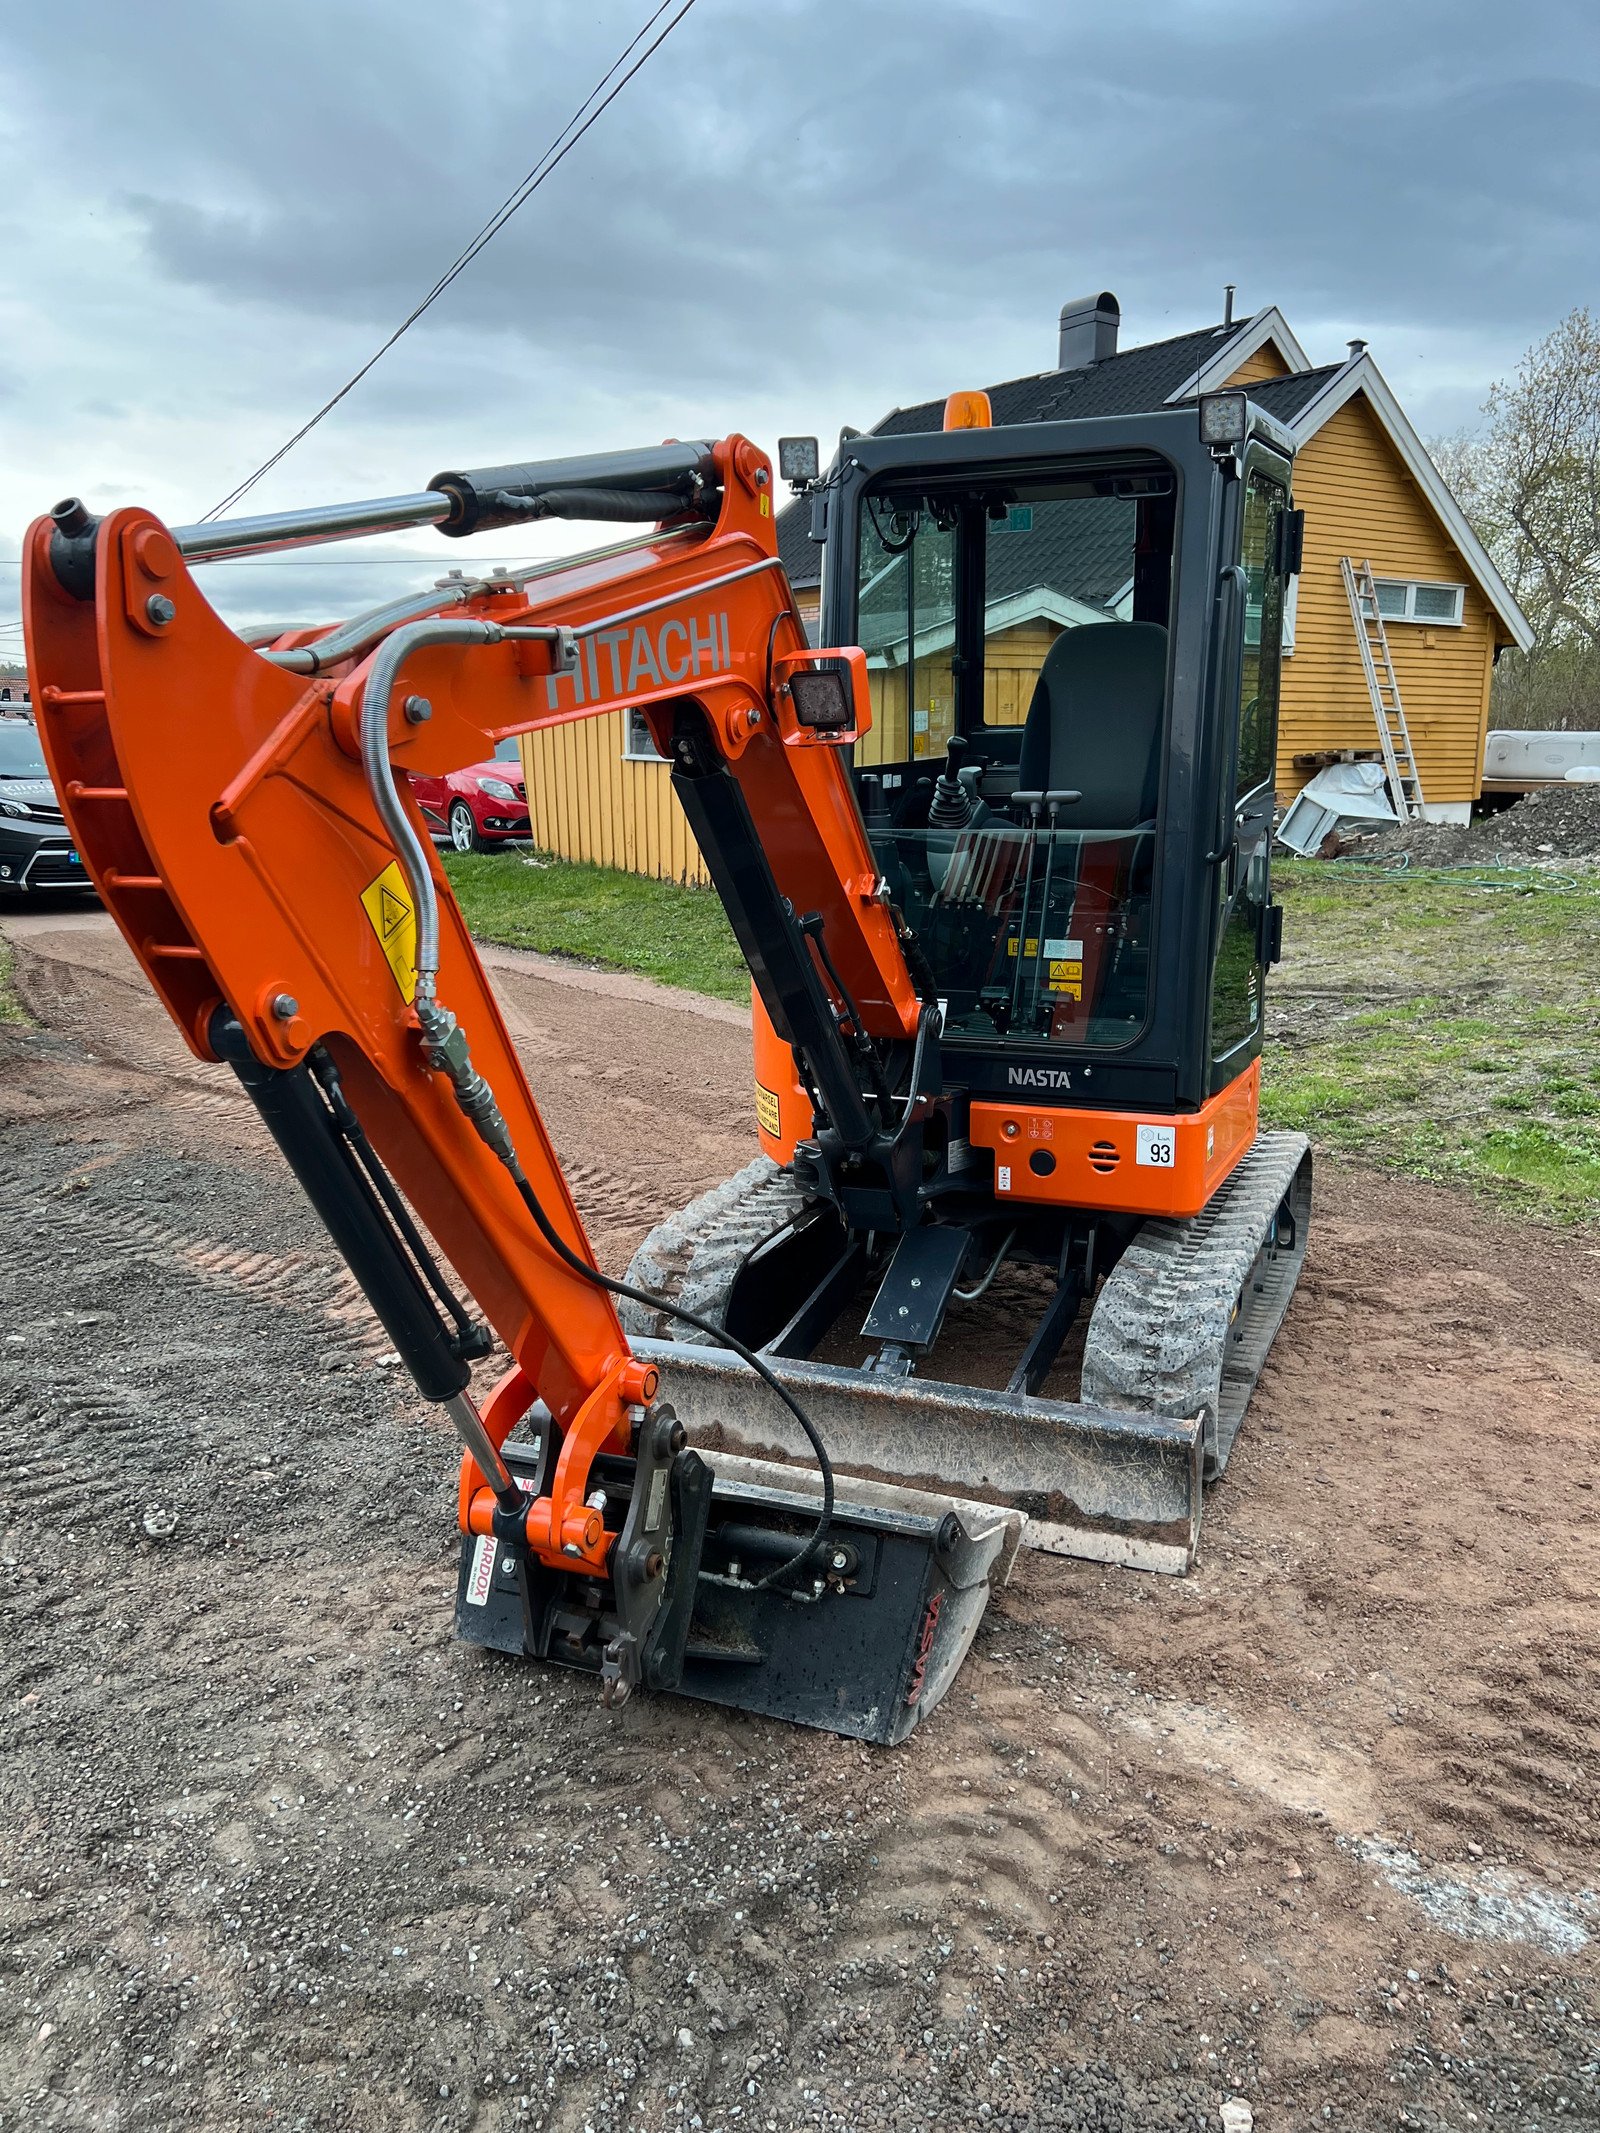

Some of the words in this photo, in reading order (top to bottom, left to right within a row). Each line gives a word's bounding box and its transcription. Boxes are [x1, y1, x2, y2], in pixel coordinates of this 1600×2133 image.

[545, 612, 731, 710] HITACHI
[1008, 1067, 1071, 1089] NASTA
[1150, 1143, 1170, 1163] 93
[475, 1535, 495, 1600] HARDOX
[907, 1592, 942, 1705] NASTA
